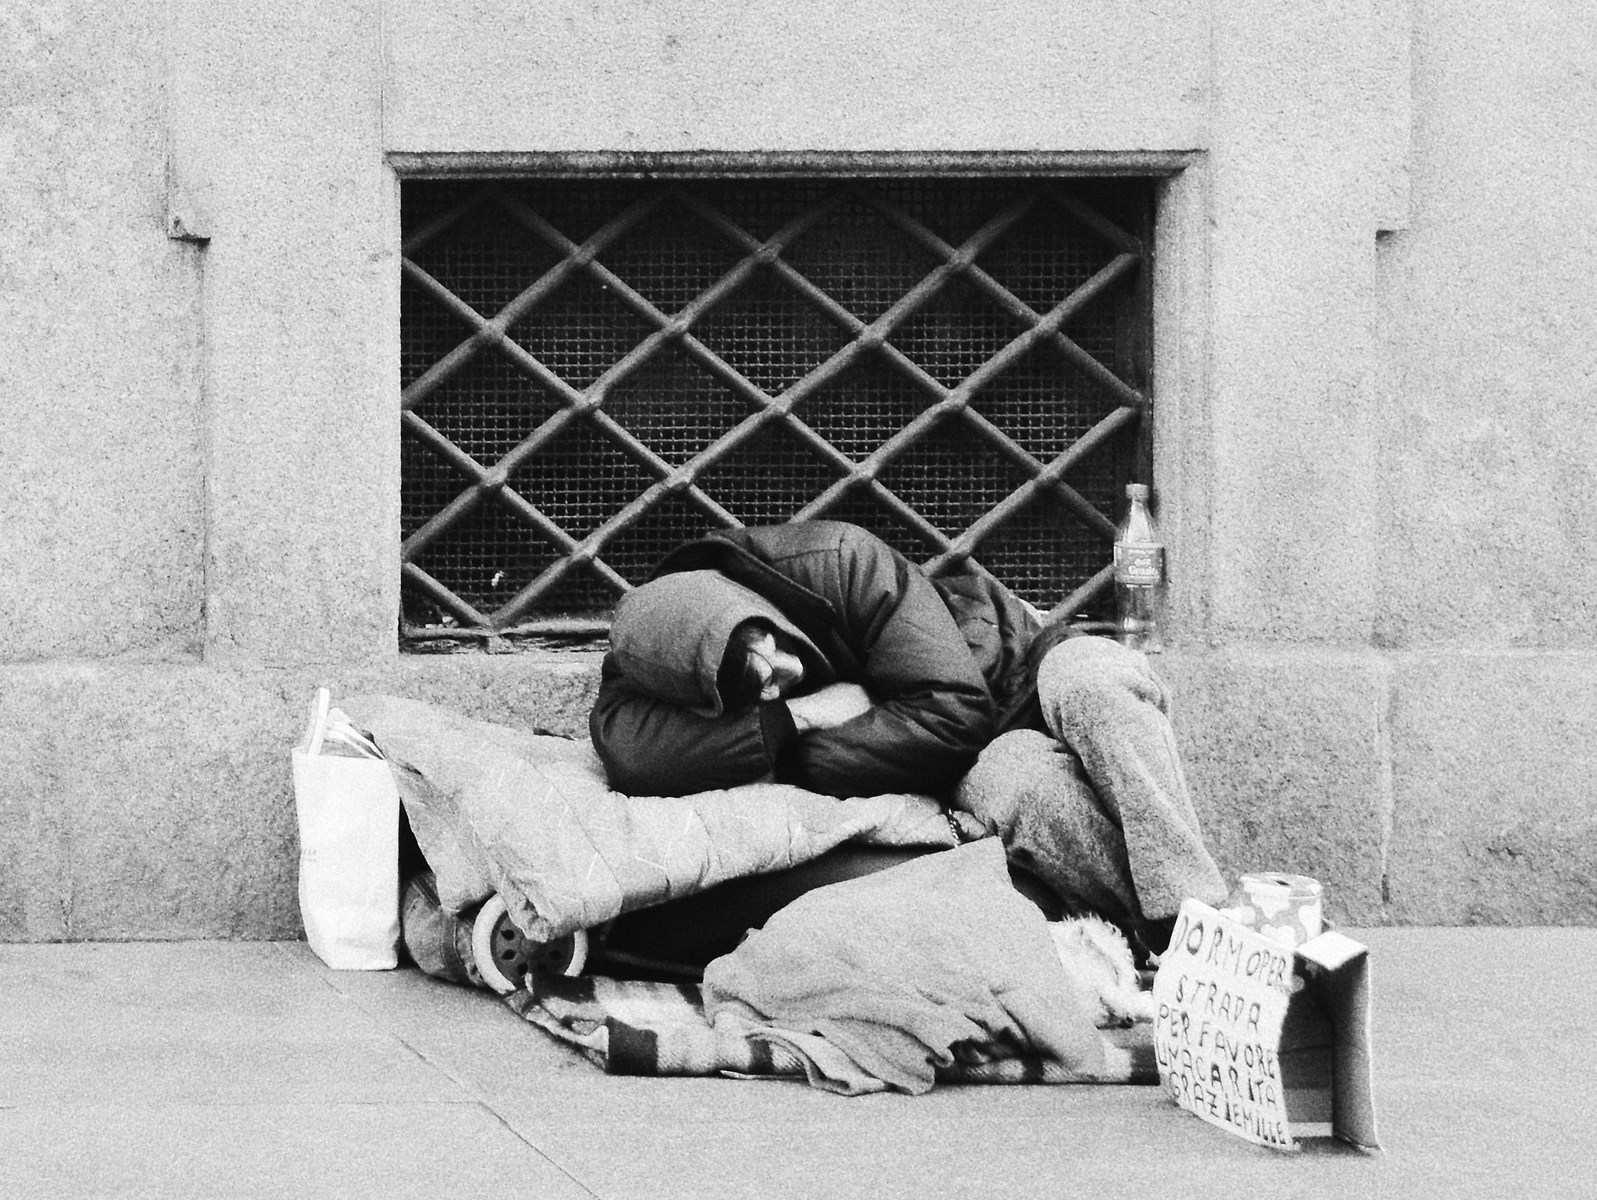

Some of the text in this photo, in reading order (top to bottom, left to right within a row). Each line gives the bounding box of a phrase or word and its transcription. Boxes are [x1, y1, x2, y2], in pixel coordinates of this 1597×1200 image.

[1176, 974, 1261, 1034] STRADA
[1156, 1004, 1275, 1079] PER FAVORE
